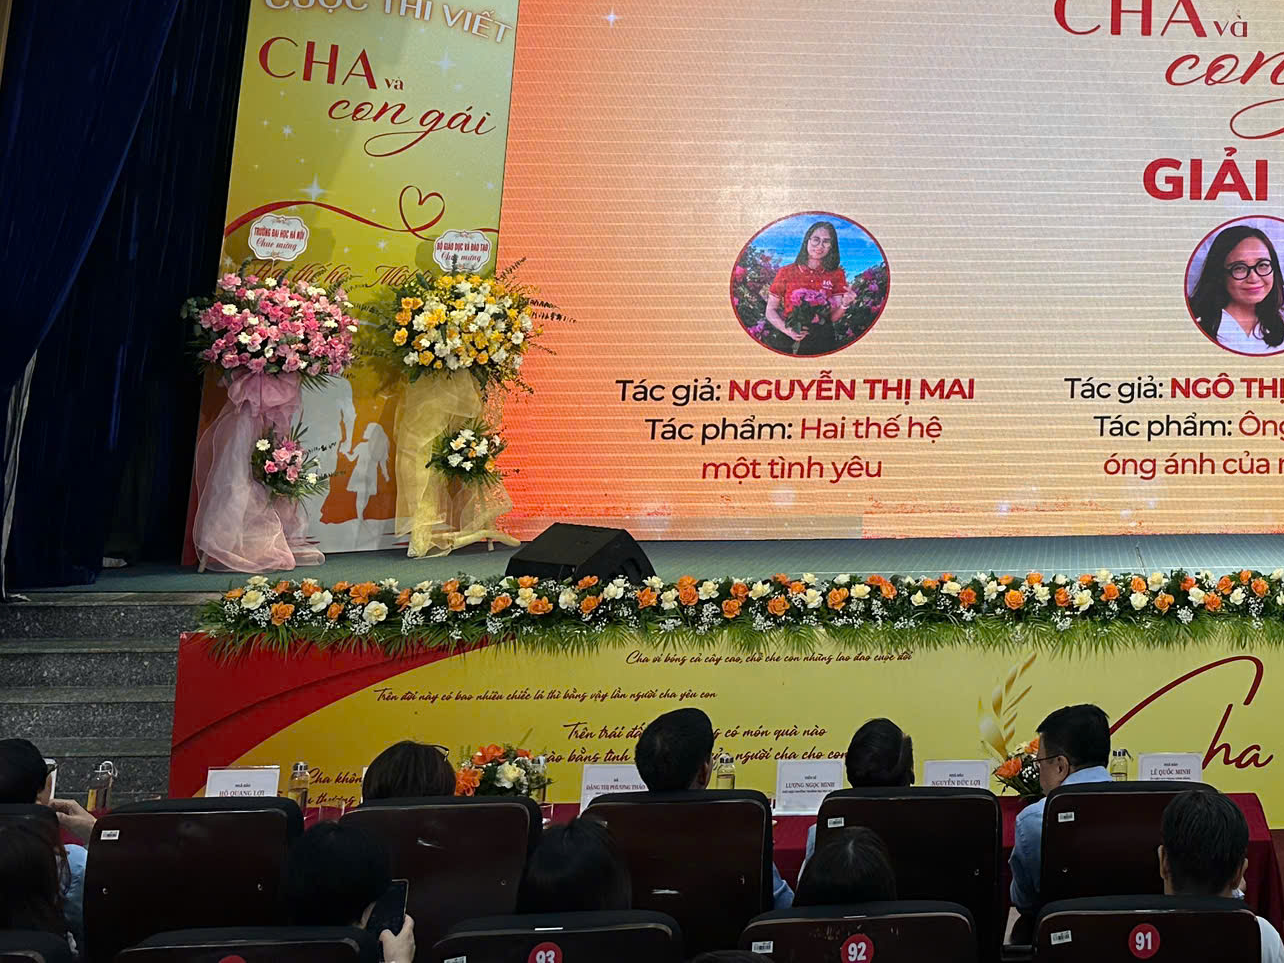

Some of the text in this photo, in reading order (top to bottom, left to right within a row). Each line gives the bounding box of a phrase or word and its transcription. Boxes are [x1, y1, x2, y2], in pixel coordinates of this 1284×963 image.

[442, 5, 513, 43] VIẾT
[1213, 9, 1249, 38] và
[258, 37, 404, 91] CHA và
[328, 98, 497, 157] con gái
[1143, 146, 1268, 201] GIẢI
[615, 370, 975, 407] Tác giả: NGUYỄN THỊ MAI
[1063, 376, 1112, 400] Tác
[1117, 375, 1164, 404] giả:
[1170, 372, 1235, 399] NGÔ
[644, 413, 944, 446] Tác phẩm: Hai thế hệ
[1093, 415, 1140, 437] Tác
[1147, 412, 1233, 442] phẩm:
[701, 454, 883, 485] một tình yêu
[1103, 452, 1157, 481] óng
[1164, 451, 1215, 475] ánh
[1222, 450, 1270, 475] của
[626, 650, 650, 664] Cha
[455, 690, 473, 701] bao
[659, 688, 677, 699] cha
[700, 690, 717, 699] con
[563, 722, 596, 740] Trên
[598, 725, 625, 739] trái
[725, 725, 740, 738] có
[743, 725, 771, 738] món
[774, 725, 800, 741] quà
[802, 724, 828, 737] nào
[567, 747, 601, 763] bằng
[735, 748, 773, 765] người
[774, 746, 799, 761] cha
[801, 746, 825, 761] cho
[847, 942, 868, 962] 92
[1135, 932, 1153, 950] 91
